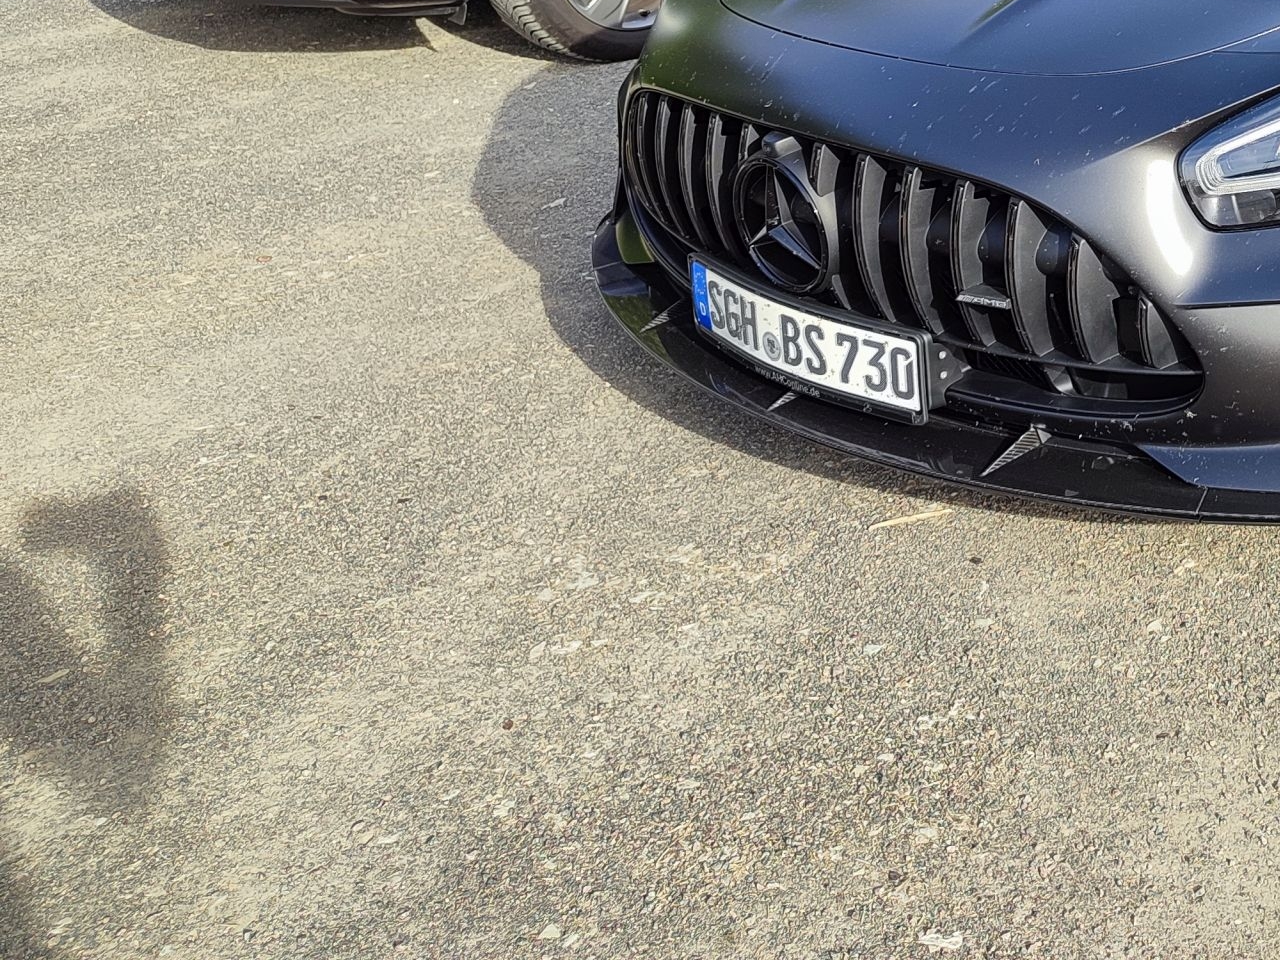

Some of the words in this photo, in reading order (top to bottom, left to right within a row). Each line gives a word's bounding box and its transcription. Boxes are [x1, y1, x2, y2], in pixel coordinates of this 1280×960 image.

[708, 280, 759, 351] SGH
[780, 314, 827, 375] BS
[836, 332, 915, 400] 730
